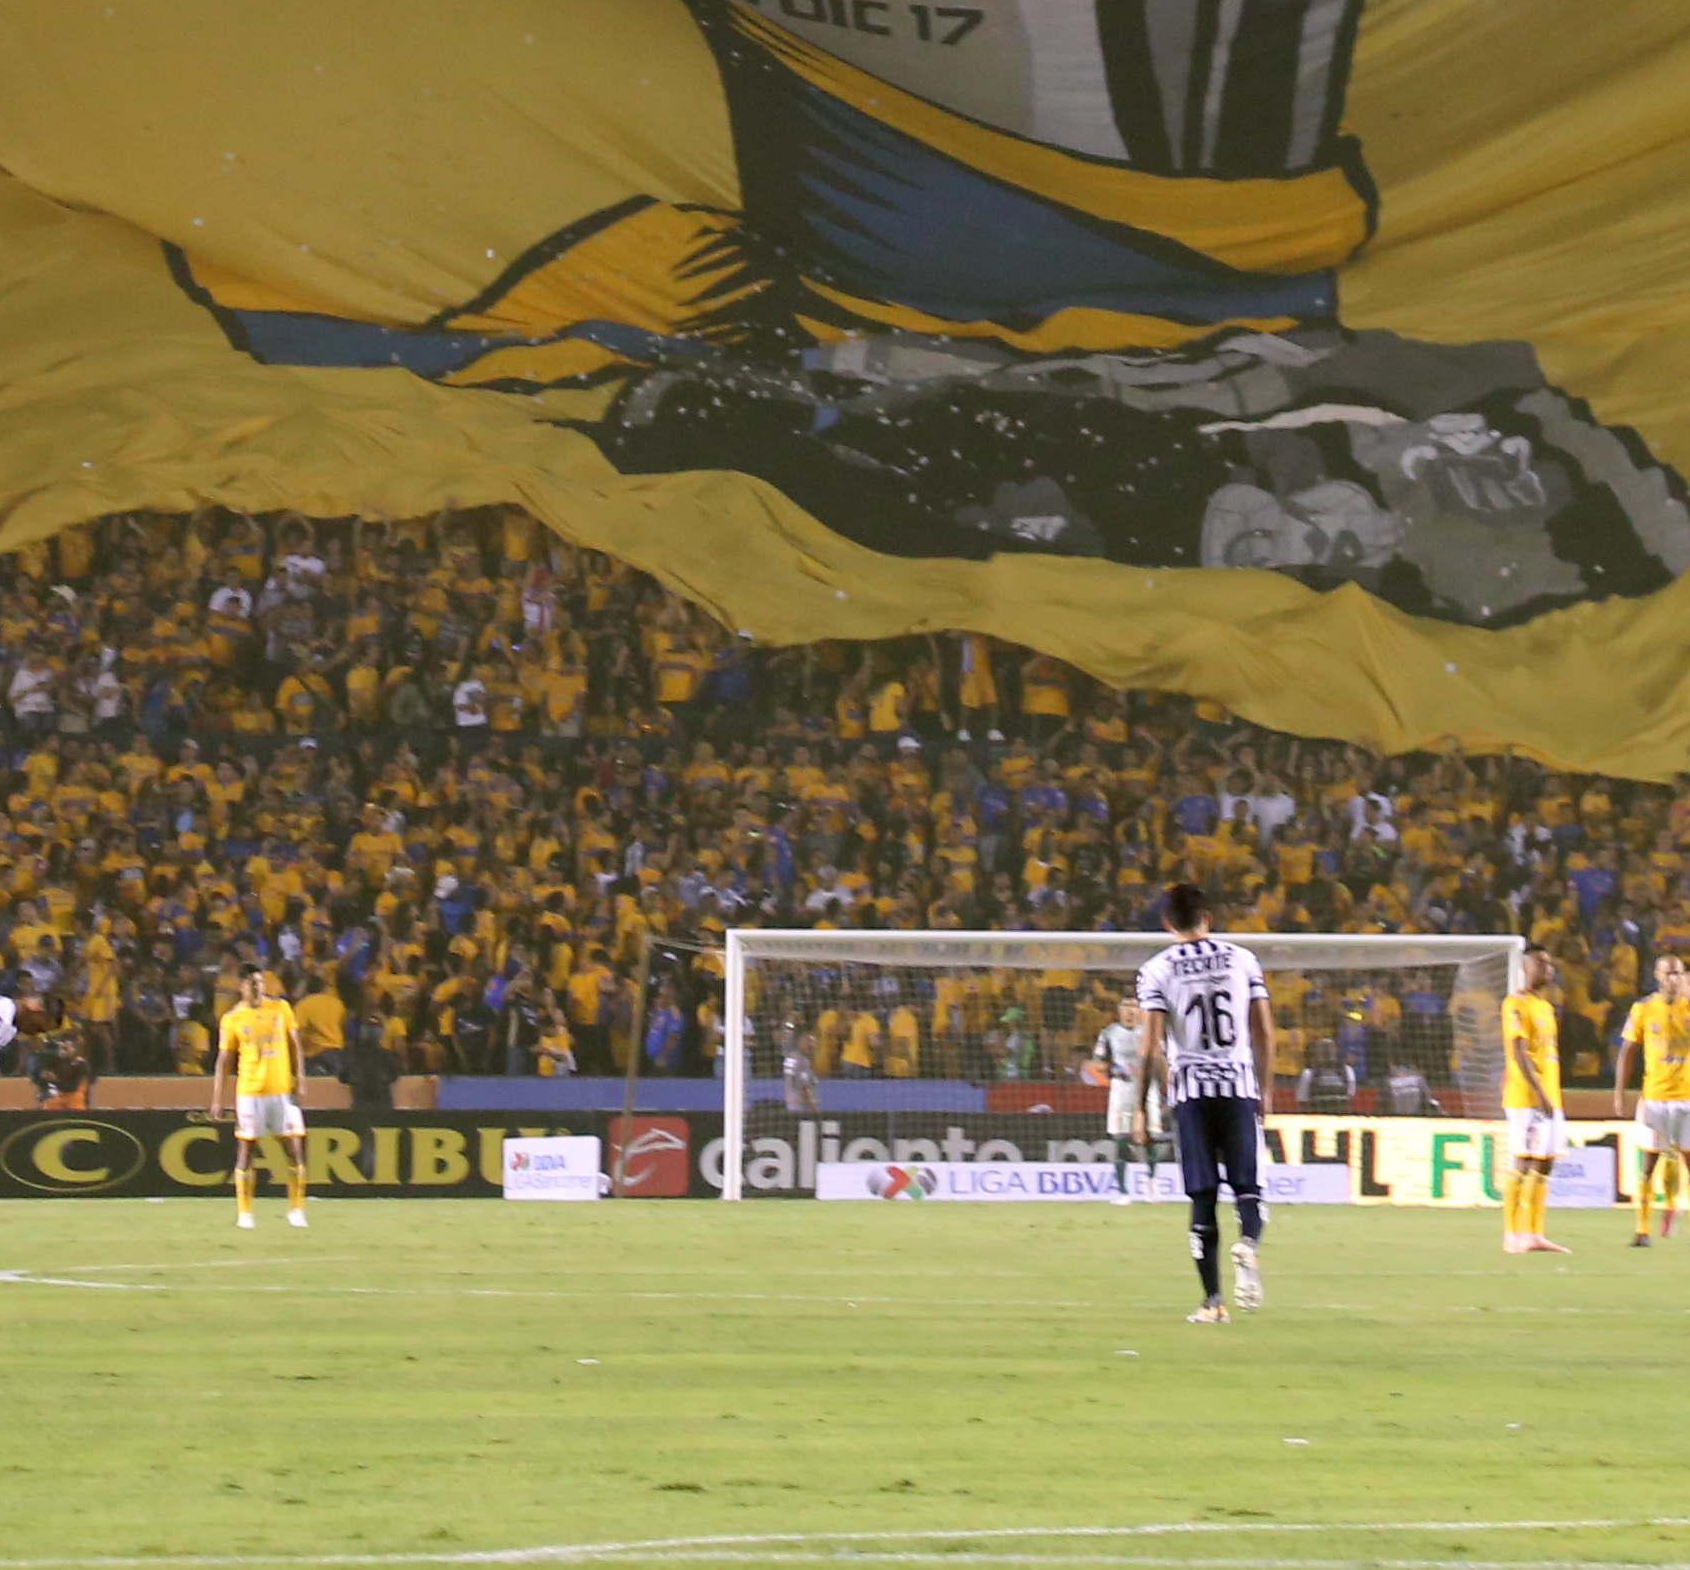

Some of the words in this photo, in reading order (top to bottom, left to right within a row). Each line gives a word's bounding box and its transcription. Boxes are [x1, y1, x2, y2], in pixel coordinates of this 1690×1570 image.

[909, 3, 985, 47] 17
[1185, 990, 1236, 1050] 16
[949, 1169, 1029, 1195] LIGA
[1036, 1170, 1124, 1194] BBVA
